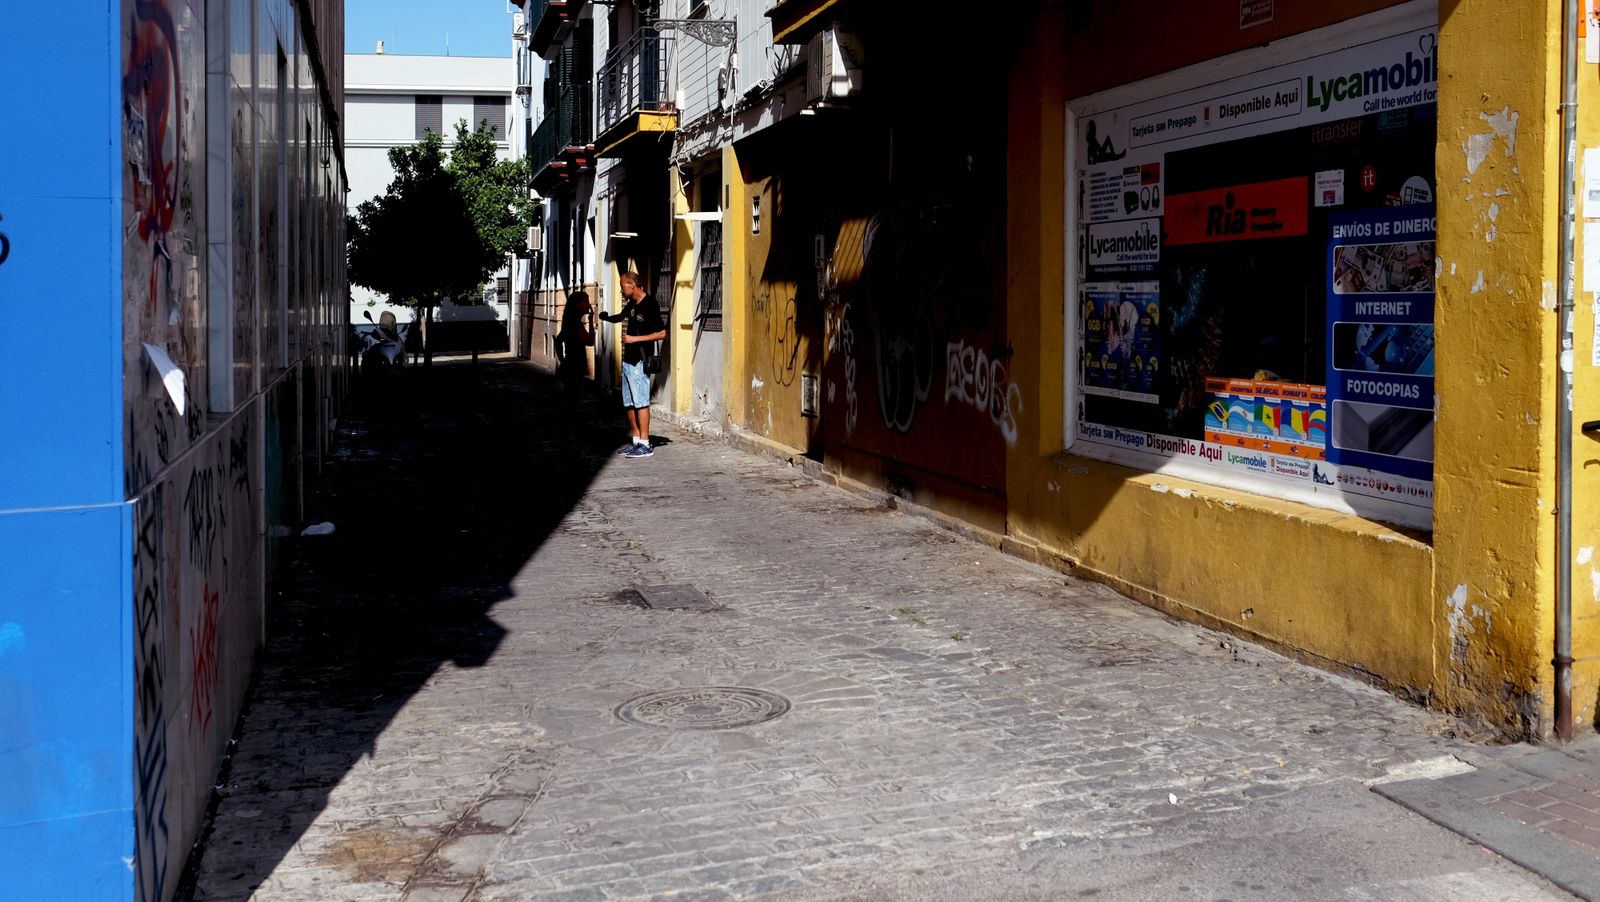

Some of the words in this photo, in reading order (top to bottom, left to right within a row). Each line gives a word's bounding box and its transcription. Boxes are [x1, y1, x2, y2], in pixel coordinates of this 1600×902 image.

[1219, 95, 1271, 119] Disponible
[1274, 87, 1298, 107] Aqui
[1363, 99, 1380, 112] Call
[1381, 96, 1396, 109] the
[1397, 90, 1422, 106] world
[1423, 88, 1437, 101] for
[1132, 124, 1154, 138] Tarjeta
[1167, 115, 1197, 130] Prepago
[1206, 192, 1247, 236] Ria
[1332, 220, 1372, 239] ENVÍOS
[1374, 222, 1391, 237] DE
[1090, 229, 1158, 258] Lycamobile
[1116, 254, 1124, 262] Call
[1131, 252, 1143, 261] world
[1149, 251, 1158, 260] less
[1355, 301, 1412, 316] INTERNET
[1346, 378, 1420, 399] FOTOCOPIAS
[1079, 423, 1102, 438] Tarjeta
[1115, 429, 1144, 447] Prepago
[1146, 433, 1196, 456] Disponible
[1198, 442, 1222, 462] Aqui
[1227, 451, 1267, 469] Lycamobile
[1276, 465, 1298, 475] Disponible
